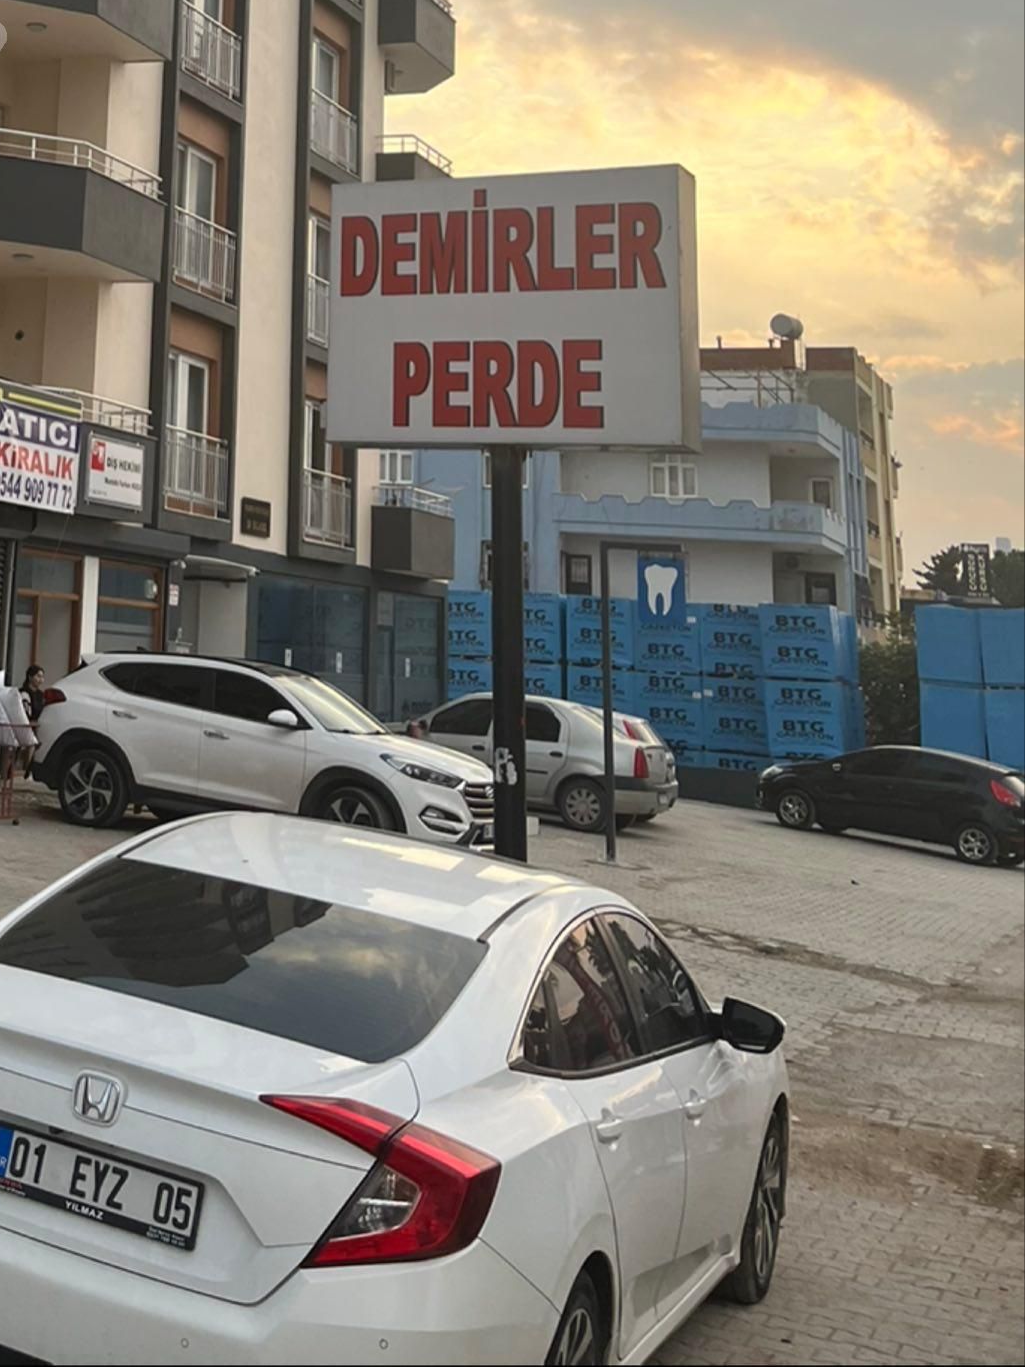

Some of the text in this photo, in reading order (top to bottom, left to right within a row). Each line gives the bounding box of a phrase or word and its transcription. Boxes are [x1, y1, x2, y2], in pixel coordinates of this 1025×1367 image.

[340, 189, 667, 296] DEMİRLER
[392, 339, 605, 428] PERDE
[24, 477, 45, 504] 909
[47, 482, 59, 507] 77
[10, 1137, 193, 1231] 01 EYZ 05
[65, 1200, 105, 1221] YILMAZ
